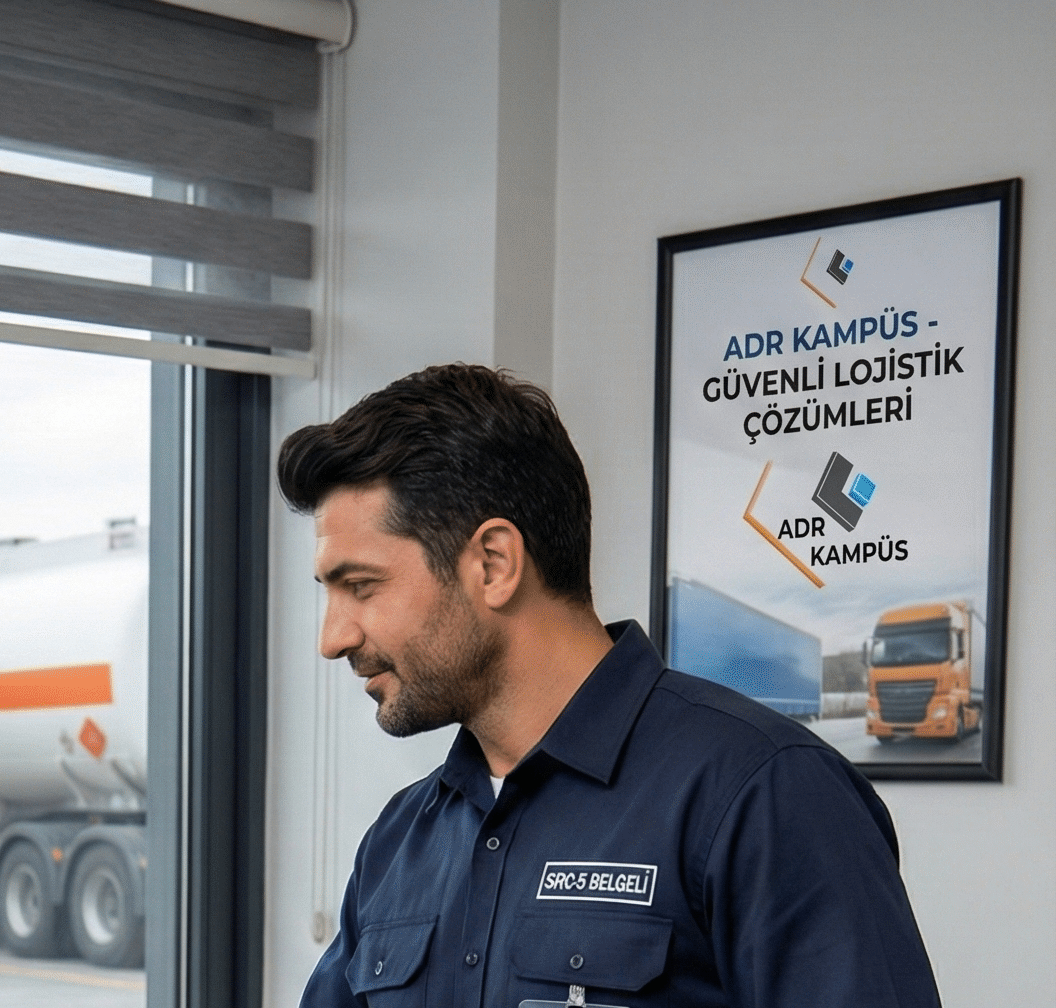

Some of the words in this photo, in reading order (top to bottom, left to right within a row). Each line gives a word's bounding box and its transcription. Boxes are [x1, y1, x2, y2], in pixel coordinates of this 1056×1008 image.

[724, 331, 783, 361] ADR
[793, 307, 919, 353] KAMPÜS
[703, 356, 824, 402] GÜVENLİ
[834, 341, 964, 388] LOJİSTİK
[744, 387, 912, 445] ÇÖZÜMLERİ
[778, 517, 825, 539] ADR
[811, 536, 908, 566] KAMPÜS
[544, 872, 588, 890] SRC-5
[588, 869, 650, 894] BELGELİ
